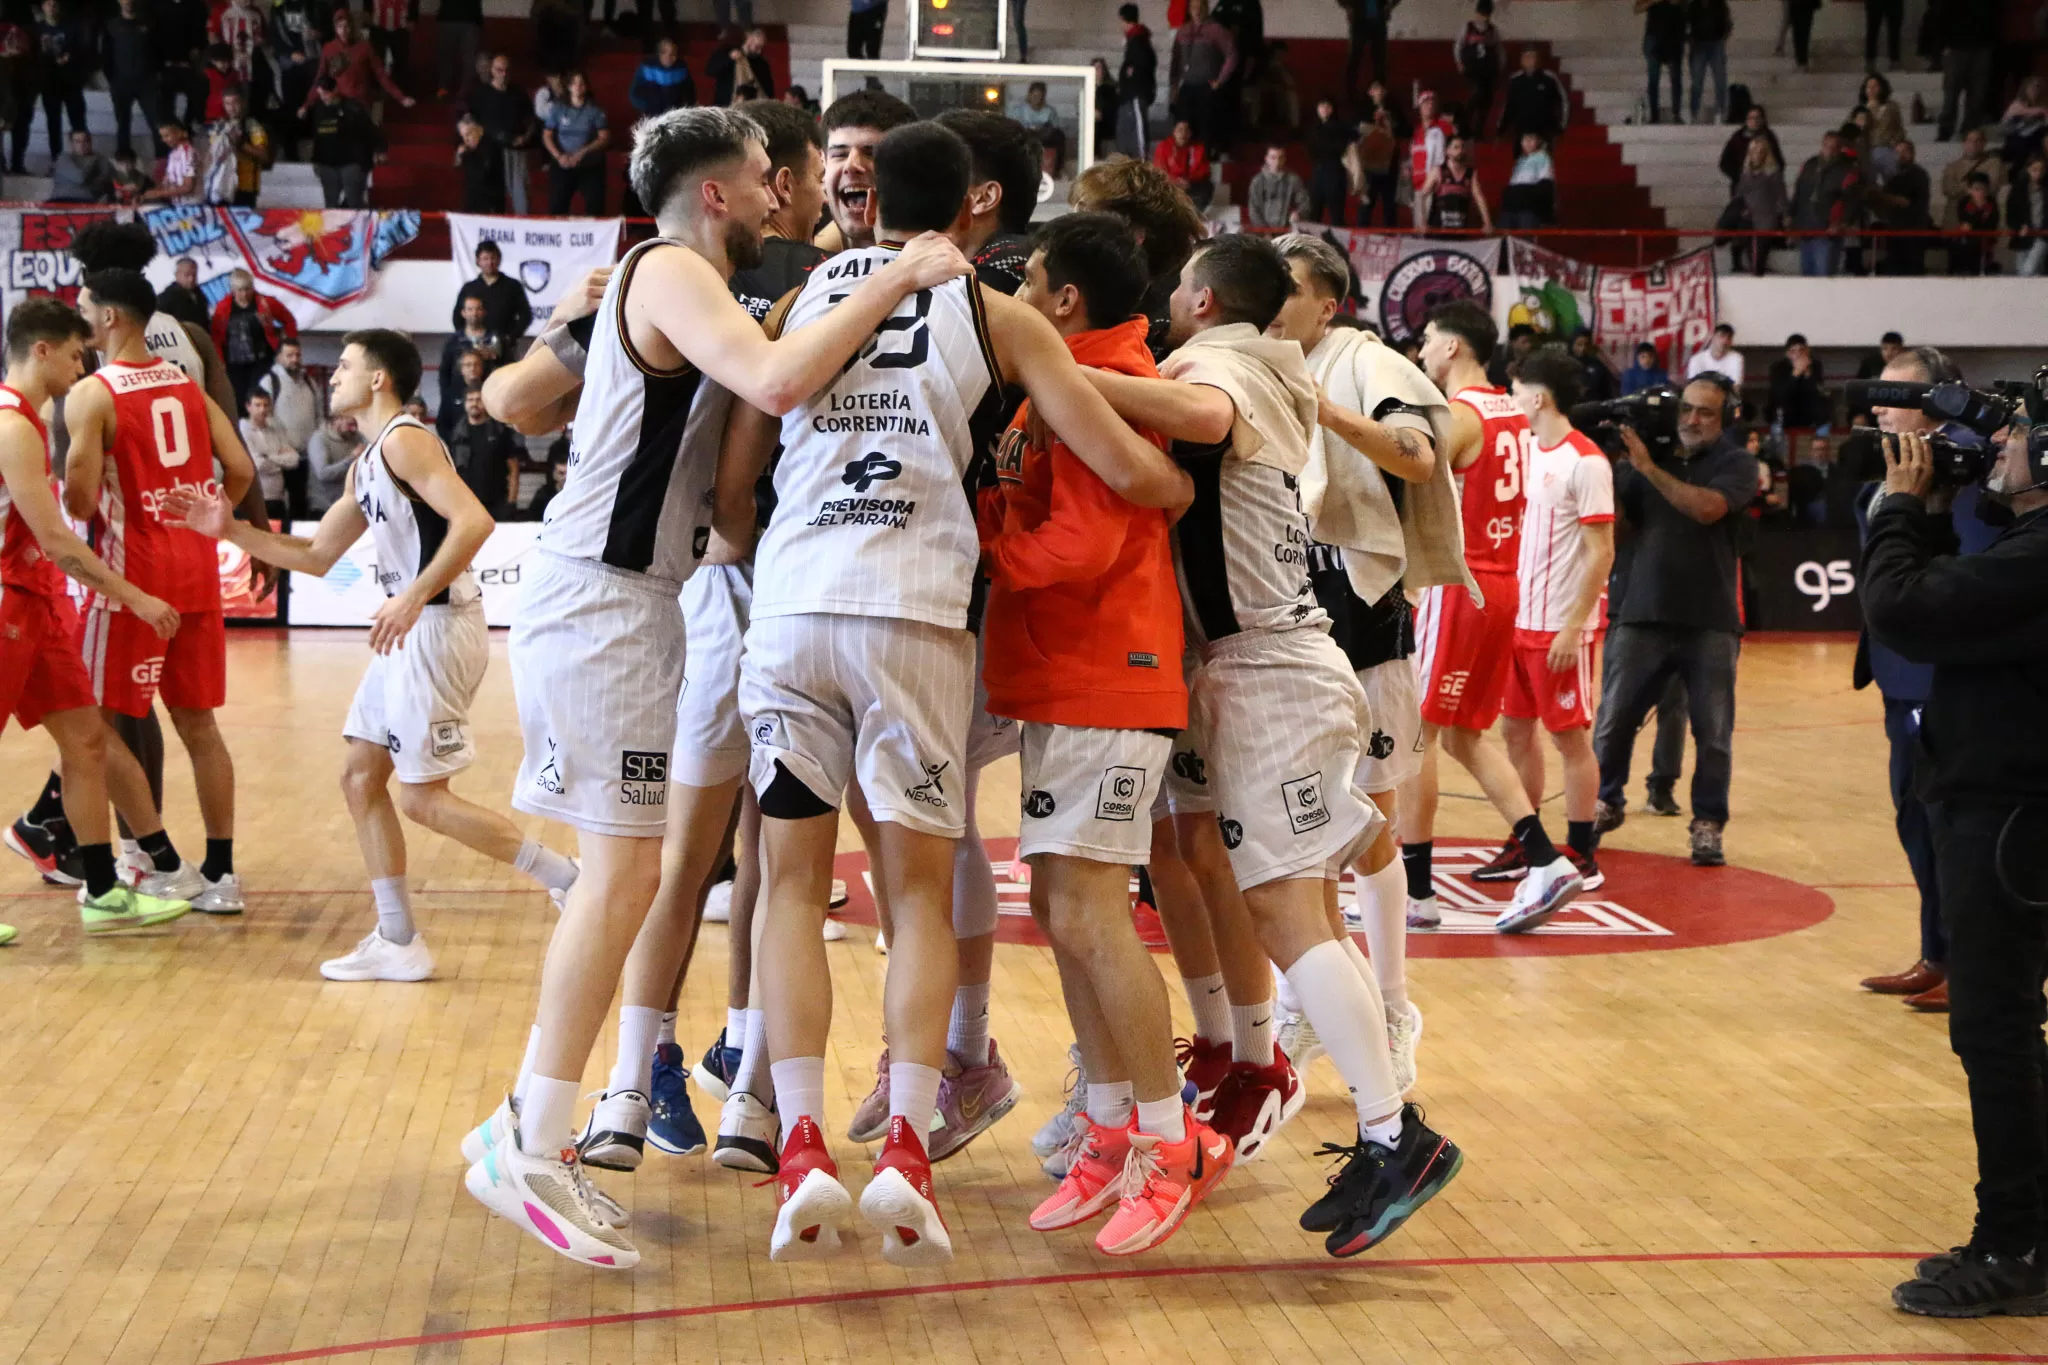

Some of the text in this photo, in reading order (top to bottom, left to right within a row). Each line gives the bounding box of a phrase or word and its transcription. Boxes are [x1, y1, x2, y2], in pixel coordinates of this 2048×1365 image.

[525, 232, 562, 247] ROWING
[570, 232, 594, 247] CLUB
[119, 369, 183, 387] JEFFERSON
[830, 389, 911, 412] LOTERÍA
[151, 396, 191, 468] 0
[812, 415, 930, 436] CORRENTINA
[819, 498, 916, 515] PREVISORA
[625, 754, 666, 780] SPS
[620, 782, 666, 806] Salud
